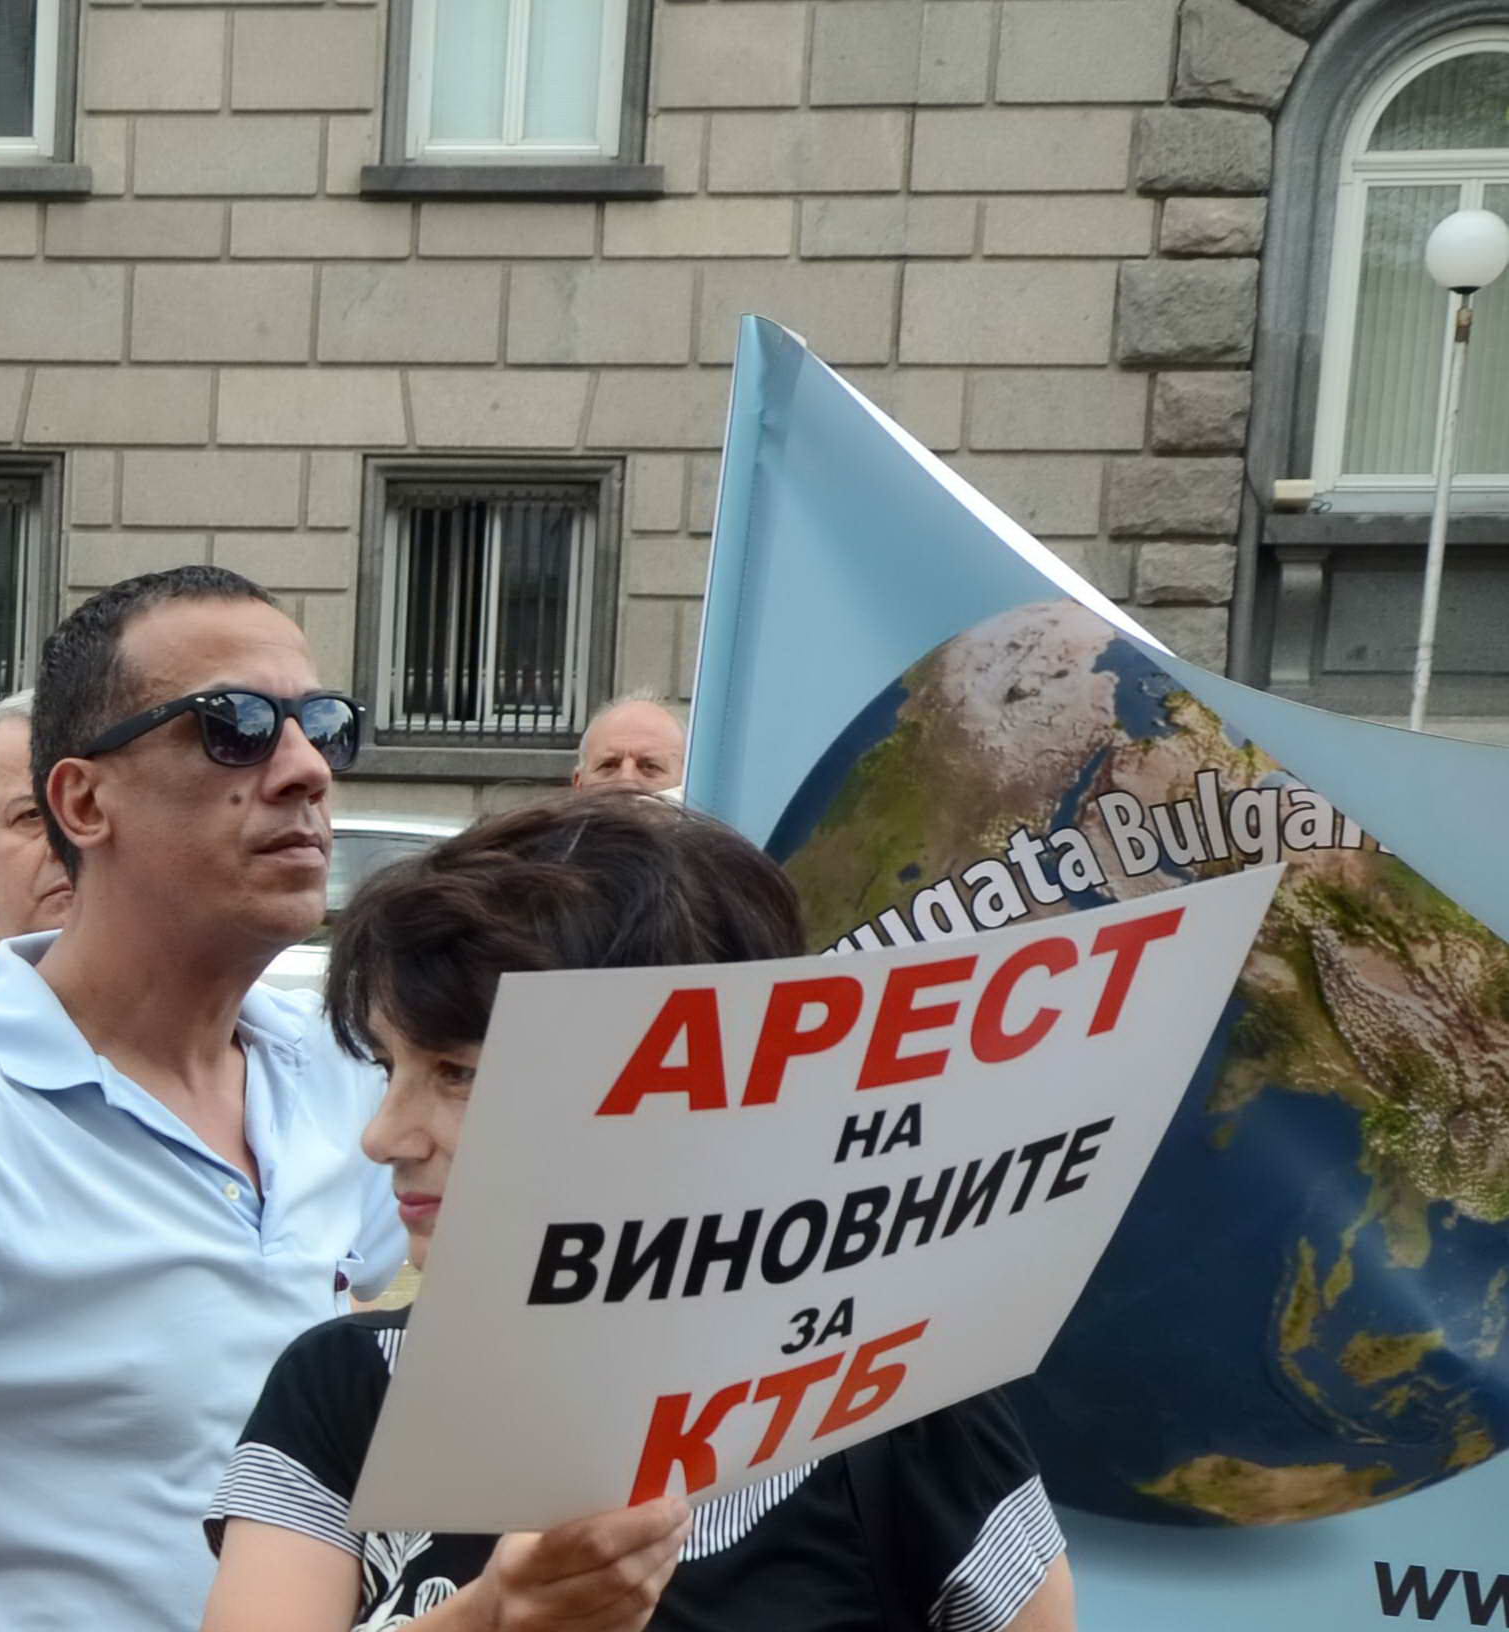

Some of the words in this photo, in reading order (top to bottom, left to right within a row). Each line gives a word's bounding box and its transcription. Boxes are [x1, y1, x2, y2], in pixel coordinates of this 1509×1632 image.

[594, 906, 1186, 1117] АРЕСТ
[523, 1115, 1116, 1308] ВИНОВНИТЕ
[833, 1102, 923, 1164] НА
[627, 1319, 930, 1508] КТБ
[779, 1295, 855, 1356] ЗА
